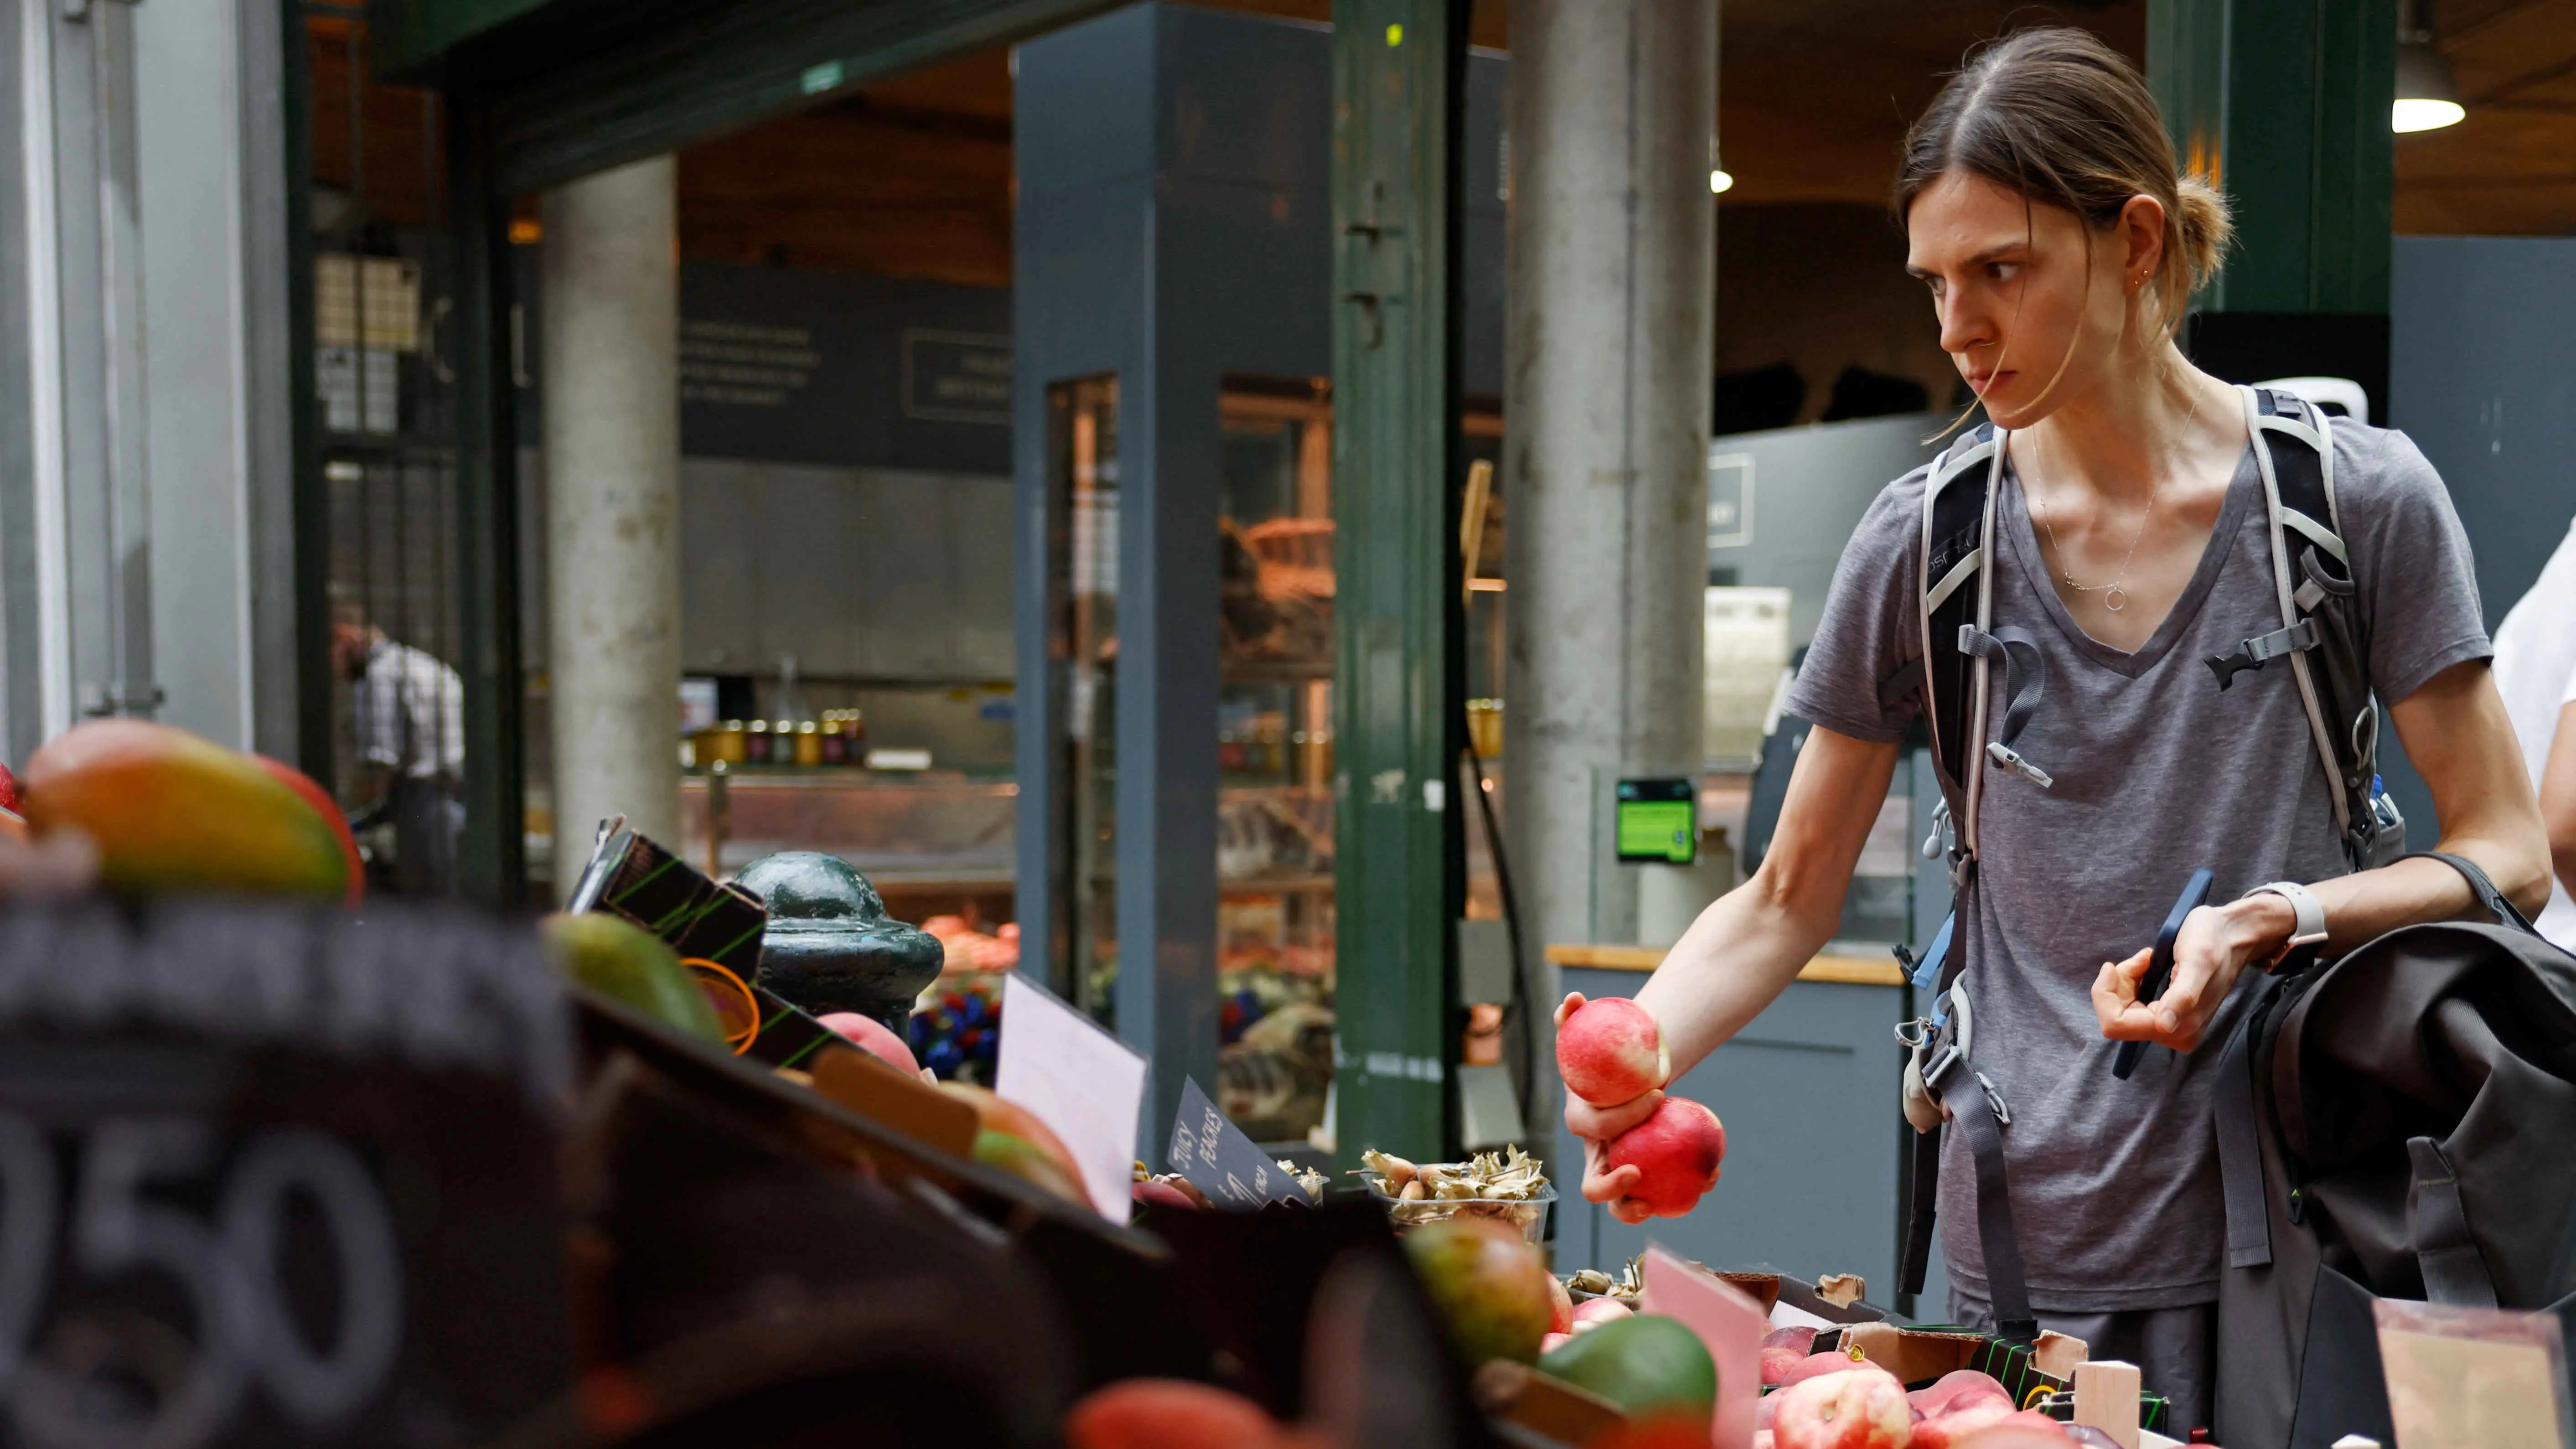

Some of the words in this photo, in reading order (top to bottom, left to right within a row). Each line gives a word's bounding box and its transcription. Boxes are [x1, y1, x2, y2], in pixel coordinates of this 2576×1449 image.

[1173, 1120, 1198, 1170] JUICY
[1199, 1107, 1224, 1170] PEACHES
[1255, 1164, 1268, 1195] EACH
